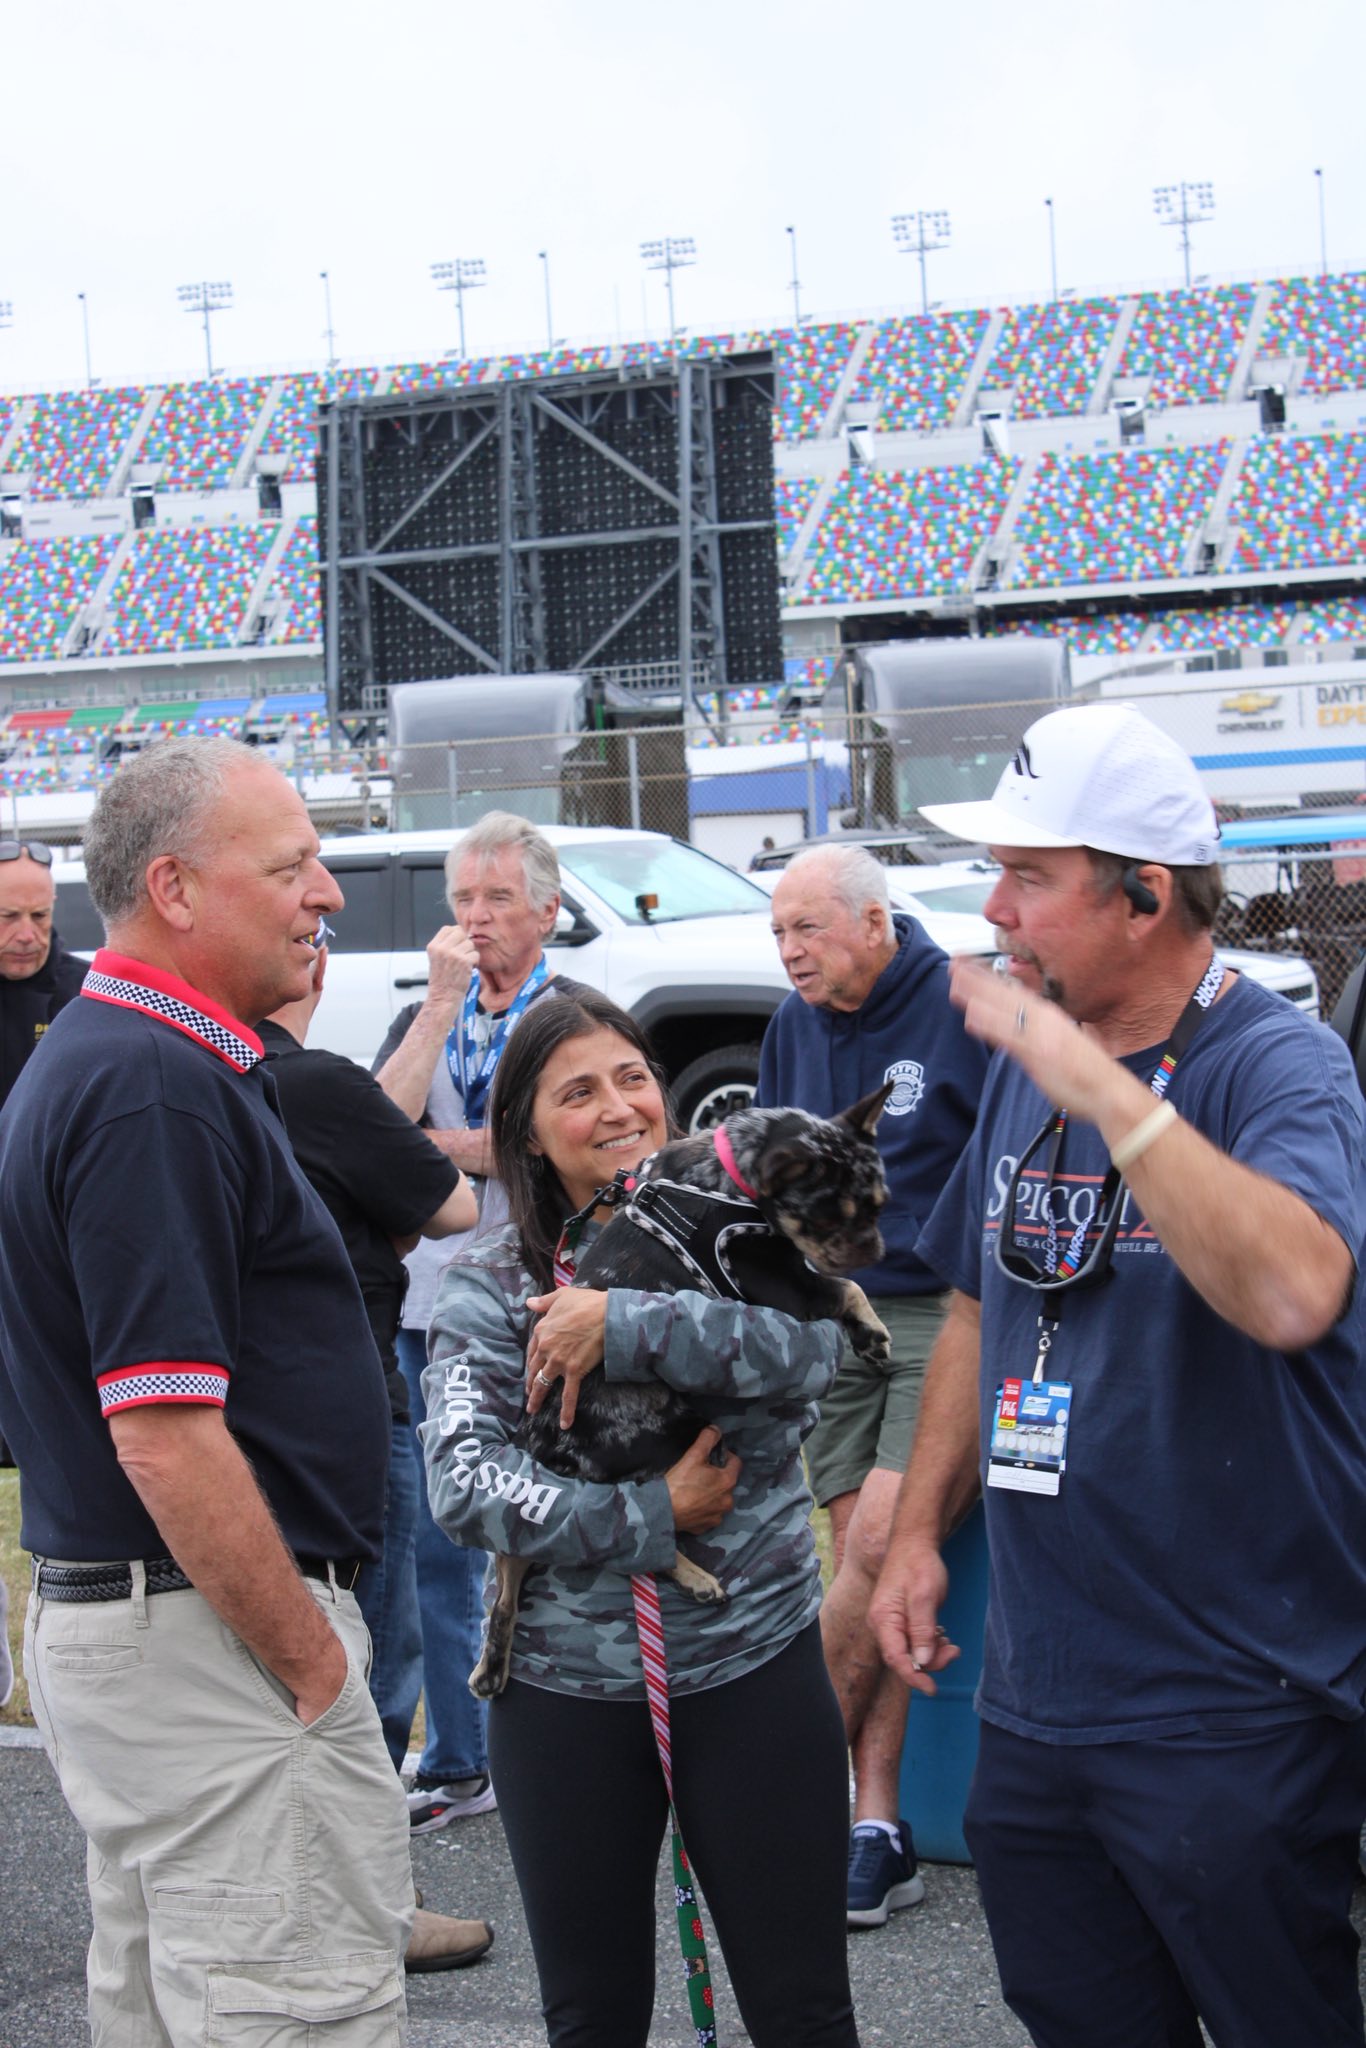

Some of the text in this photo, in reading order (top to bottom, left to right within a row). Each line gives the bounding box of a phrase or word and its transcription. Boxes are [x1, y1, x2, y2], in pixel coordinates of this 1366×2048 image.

[438, 1364, 563, 1525] Bass Po Sops
